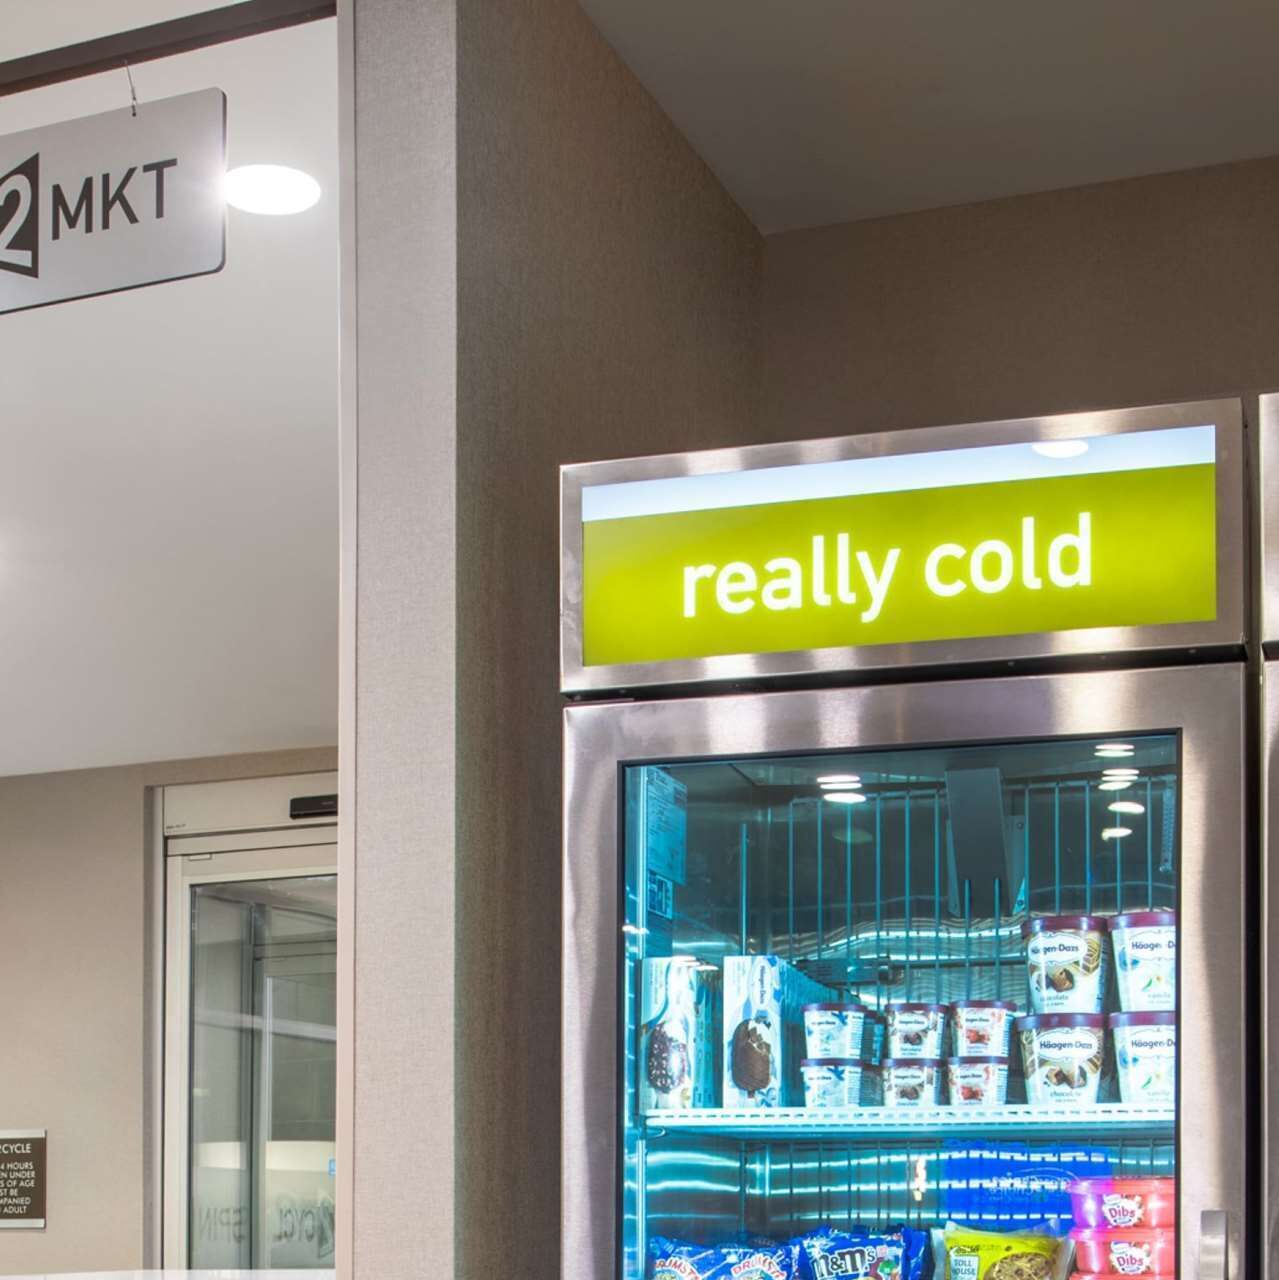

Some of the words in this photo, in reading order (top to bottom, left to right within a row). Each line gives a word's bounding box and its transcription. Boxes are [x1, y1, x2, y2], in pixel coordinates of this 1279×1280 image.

[681, 530, 901, 624] really
[923, 514, 1096, 600] cold
[7, 1161, 34, 1170] HOURS
[9, 1170, 36, 1179] UNDER
[6, 1179, 17, 1188] OF
[19, 1179, 35, 1187] AGE
[9, 1188, 19, 1196] BE
[3, 1205, 27, 1214] ADULT
[1108, 1206, 1136, 1220] Dibs
[1116, 1255, 1144, 1268] Dibs
